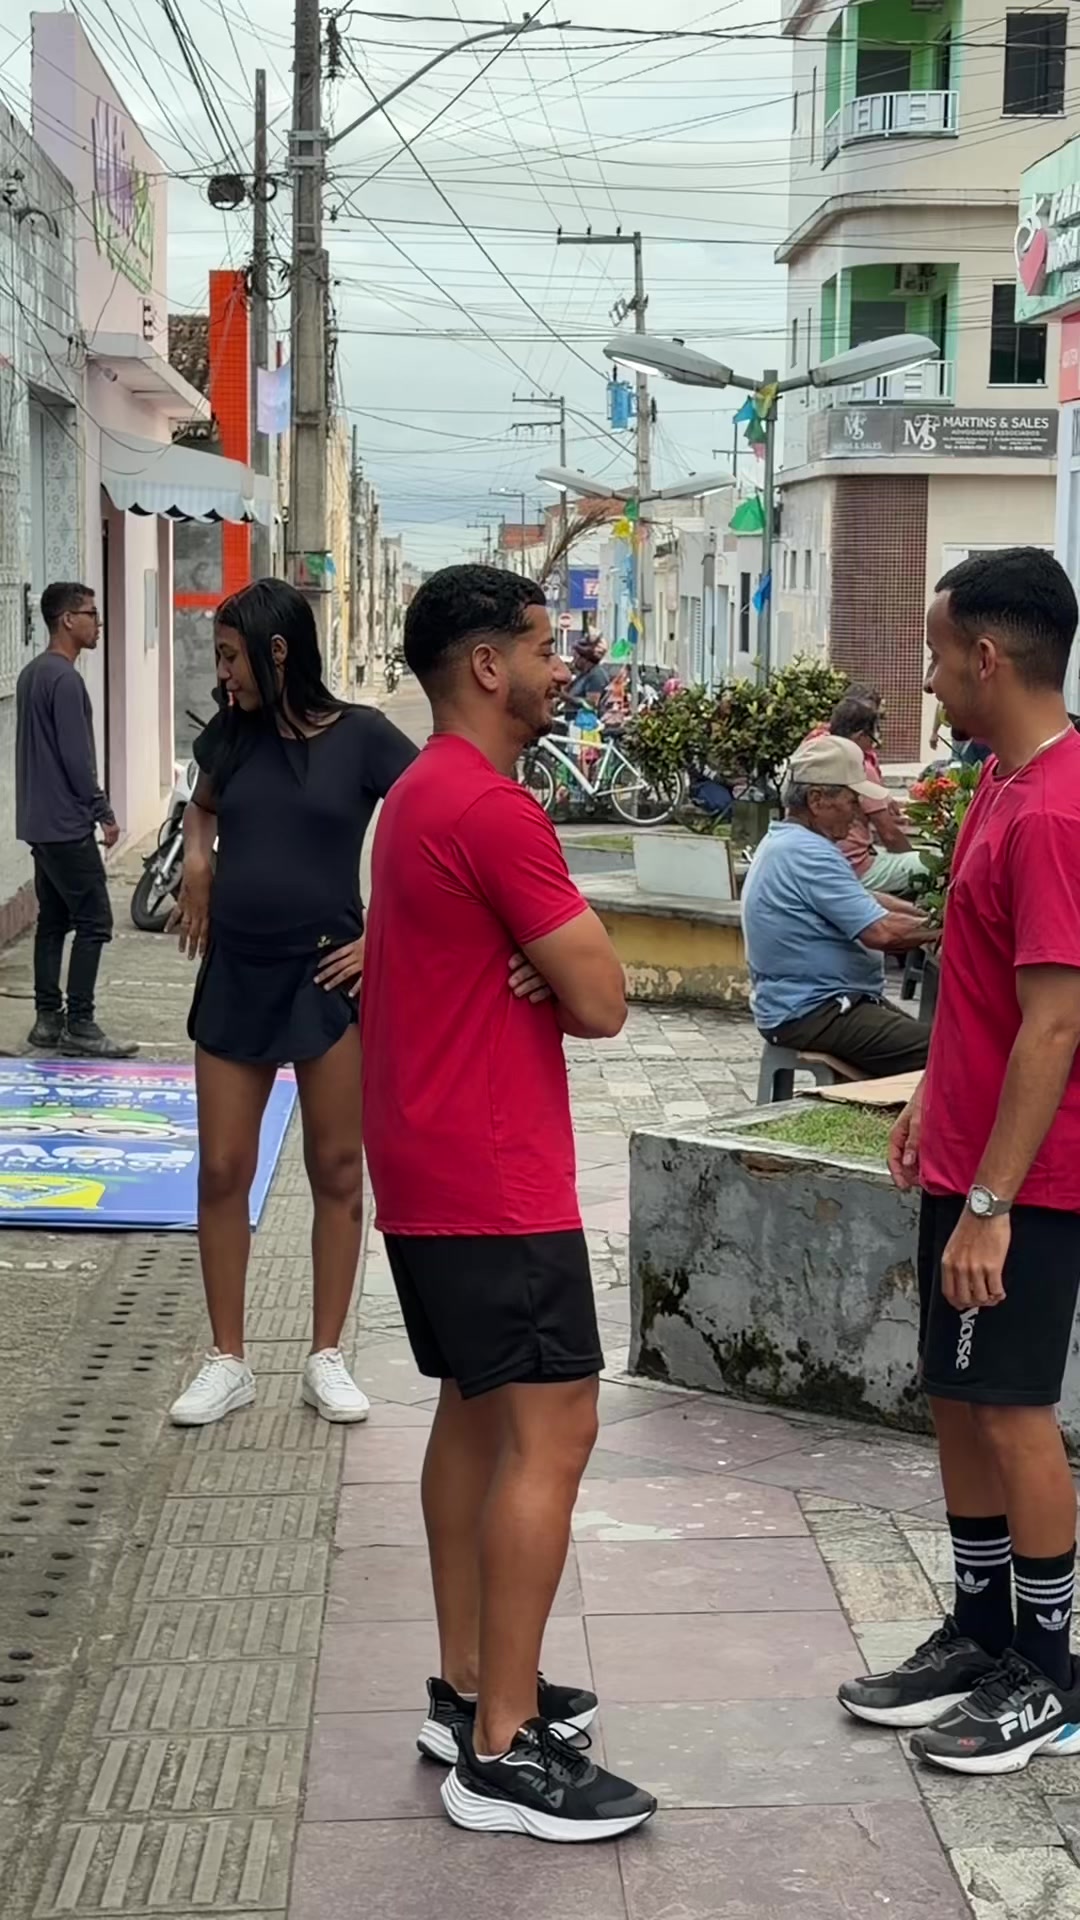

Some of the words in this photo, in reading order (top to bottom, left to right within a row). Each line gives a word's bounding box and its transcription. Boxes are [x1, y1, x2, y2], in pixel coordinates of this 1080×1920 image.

[943, 416, 997, 428] MARTINS
[1000, 417, 1008, 428] &
[1011, 417, 1049, 429] SALES
[997, 1693, 1063, 1741] FILA
